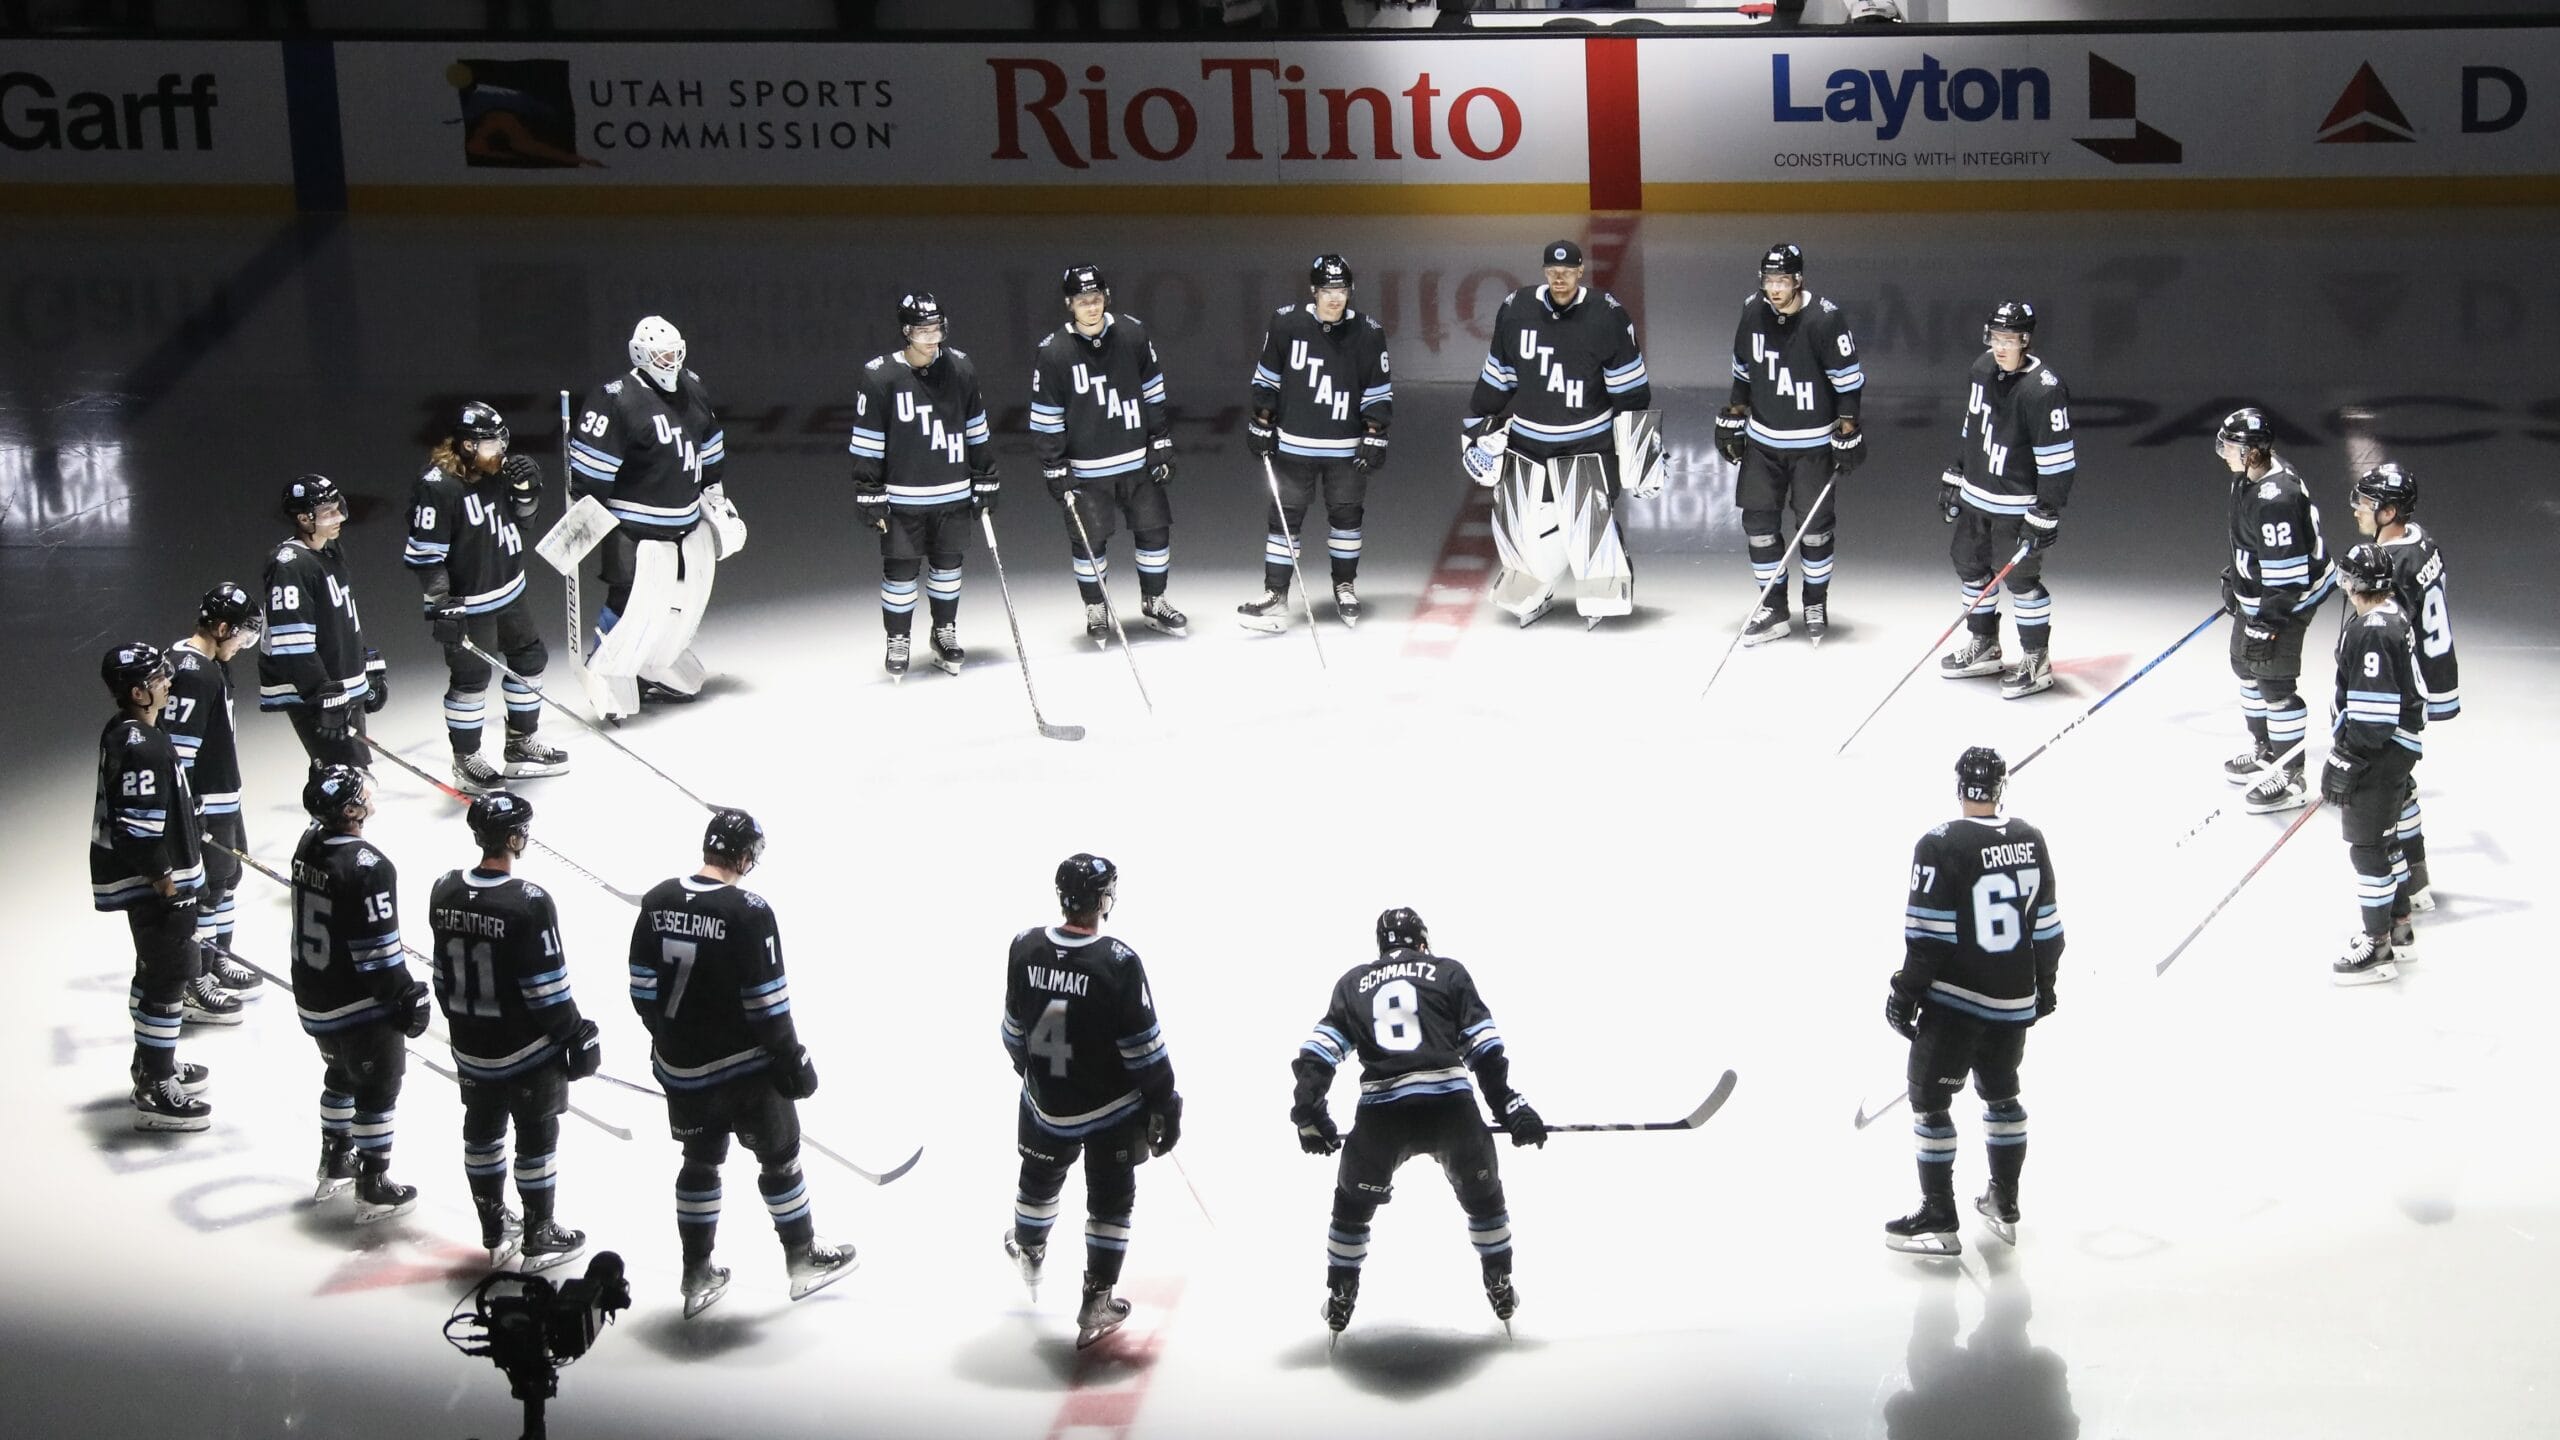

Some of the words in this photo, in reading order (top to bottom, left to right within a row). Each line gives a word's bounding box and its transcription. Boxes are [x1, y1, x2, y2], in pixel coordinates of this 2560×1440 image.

[590, 80, 703, 108] UTAH
[730, 80, 893, 108] SPORTS
[1773, 53, 2050, 140] Layton
[2462, 66, 2527, 133] D
[0, 71, 218, 151] Garff
[594, 122, 892, 149] COMMISSION
[1774, 152, 1907, 167] CONSTRUCTING
[1914, 152, 1956, 166] WITH
[1962, 151, 2051, 166] INTEGRITY
[1290, 339, 1350, 421] UTAH
[1520, 330, 1584, 409] UTAH
[1752, 332, 1815, 411] UTAH
[1072, 363, 1142, 430] UTAH
[580, 411, 609, 438] 39
[896, 391, 965, 464] UTAH
[1969, 383, 2009, 477] UTAH
[653, 414, 703, 483] UTAH
[2261, 522, 2293, 547] 92
[271, 585, 300, 611] 28
[2363, 652, 2380, 678] 9
[164, 695, 196, 724] 27
[122, 769, 156, 797] 22
[1967, 787, 1983, 800] 67
[1981, 842, 2037, 869] CROUSE
[1911, 863, 1936, 894] 67
[364, 891, 394, 924] 15
[1972, 867, 2041, 954] 67
[764, 935, 777, 966] 7
[446, 937, 503, 1018] 11
[661, 936, 698, 1020] 7
[1027, 965, 1090, 997] VALIMAKI
[1358, 962, 1437, 993] SCHMALTZ
[1141, 982, 1152, 1010] 4
[1372, 979, 1424, 1052] 8
[1030, 999, 1075, 1079] 4
